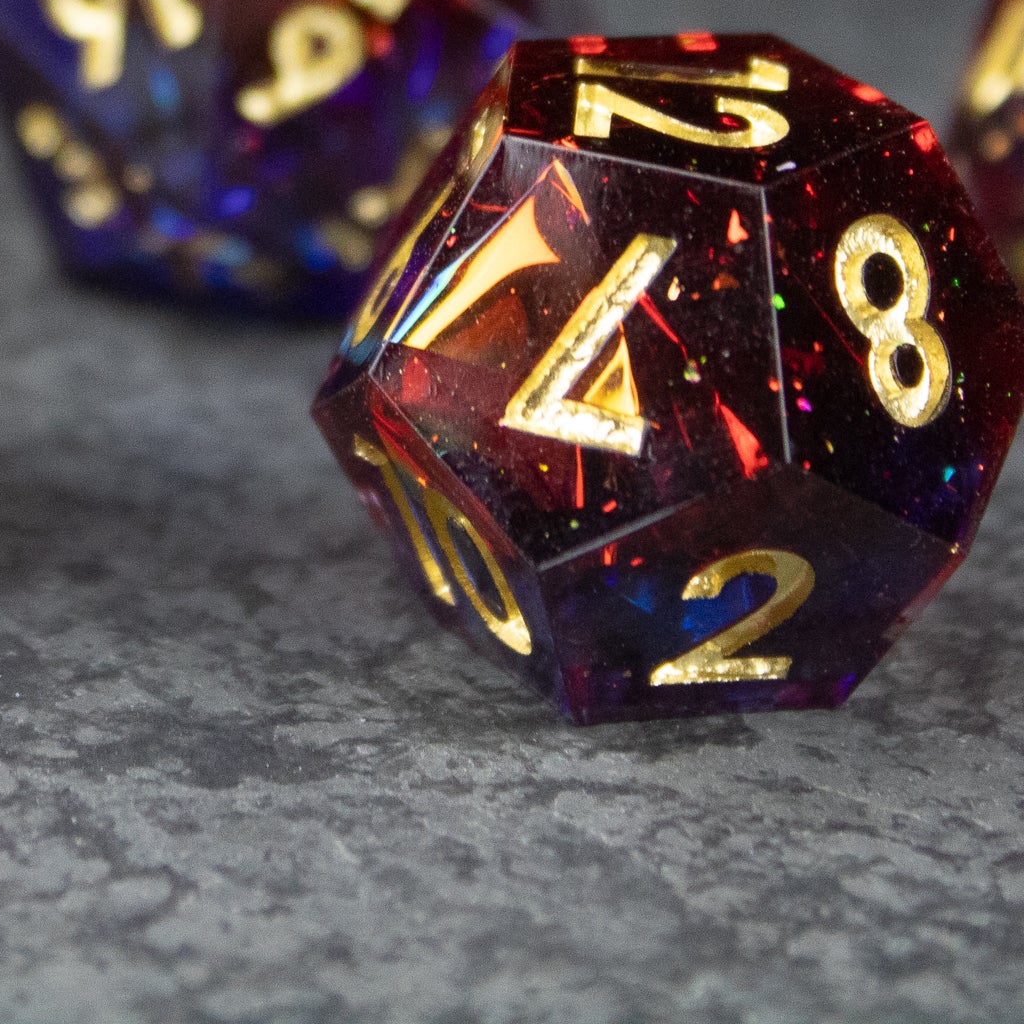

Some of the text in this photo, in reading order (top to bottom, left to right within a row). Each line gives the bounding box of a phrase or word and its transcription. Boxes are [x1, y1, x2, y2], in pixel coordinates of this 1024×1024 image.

[574, 57, 790, 148] 12
[502, 233, 678, 457] 7
[834, 214, 952, 428] 8
[352, 433, 532, 656] 10
[649, 549, 816, 688] 2
